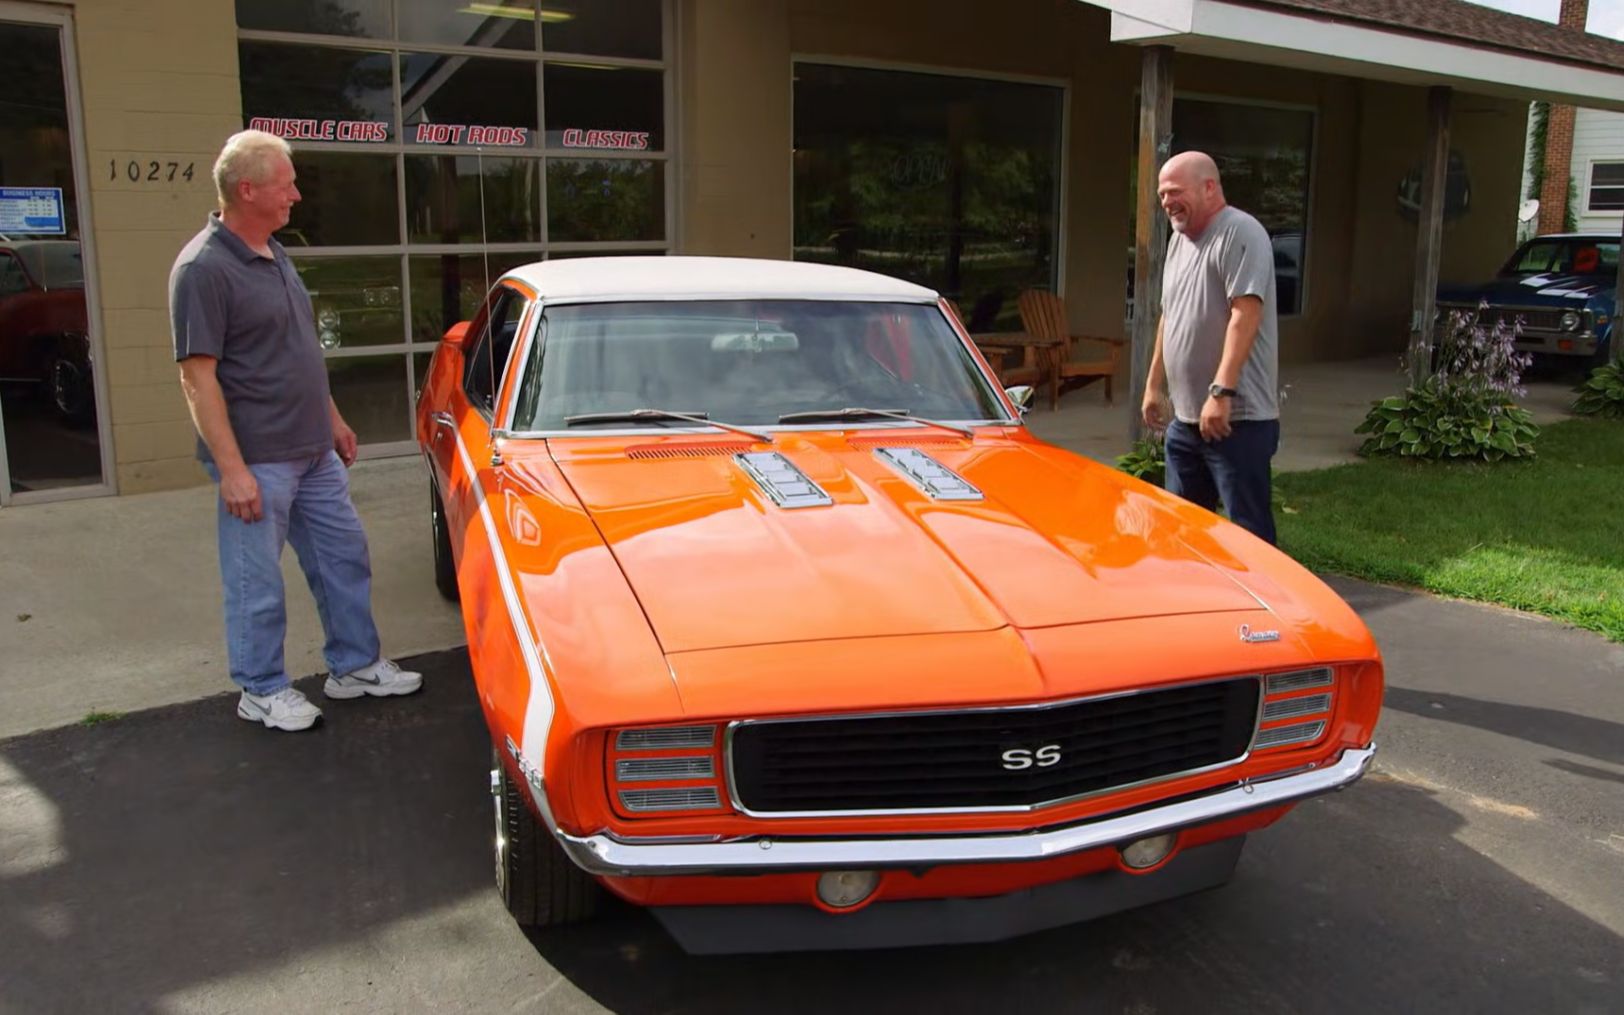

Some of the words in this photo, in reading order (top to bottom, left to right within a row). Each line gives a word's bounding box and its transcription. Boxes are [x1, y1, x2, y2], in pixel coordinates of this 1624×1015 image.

[249, 117, 336, 140] MUSCLE
[337, 120, 388, 142] CARS
[416, 123, 466, 144] HOT
[467, 125, 528, 146] RODS
[563, 128, 649, 149] CLASSICS
[110, 158, 195, 182] 10274
[1002, 744, 1061, 770] SS
